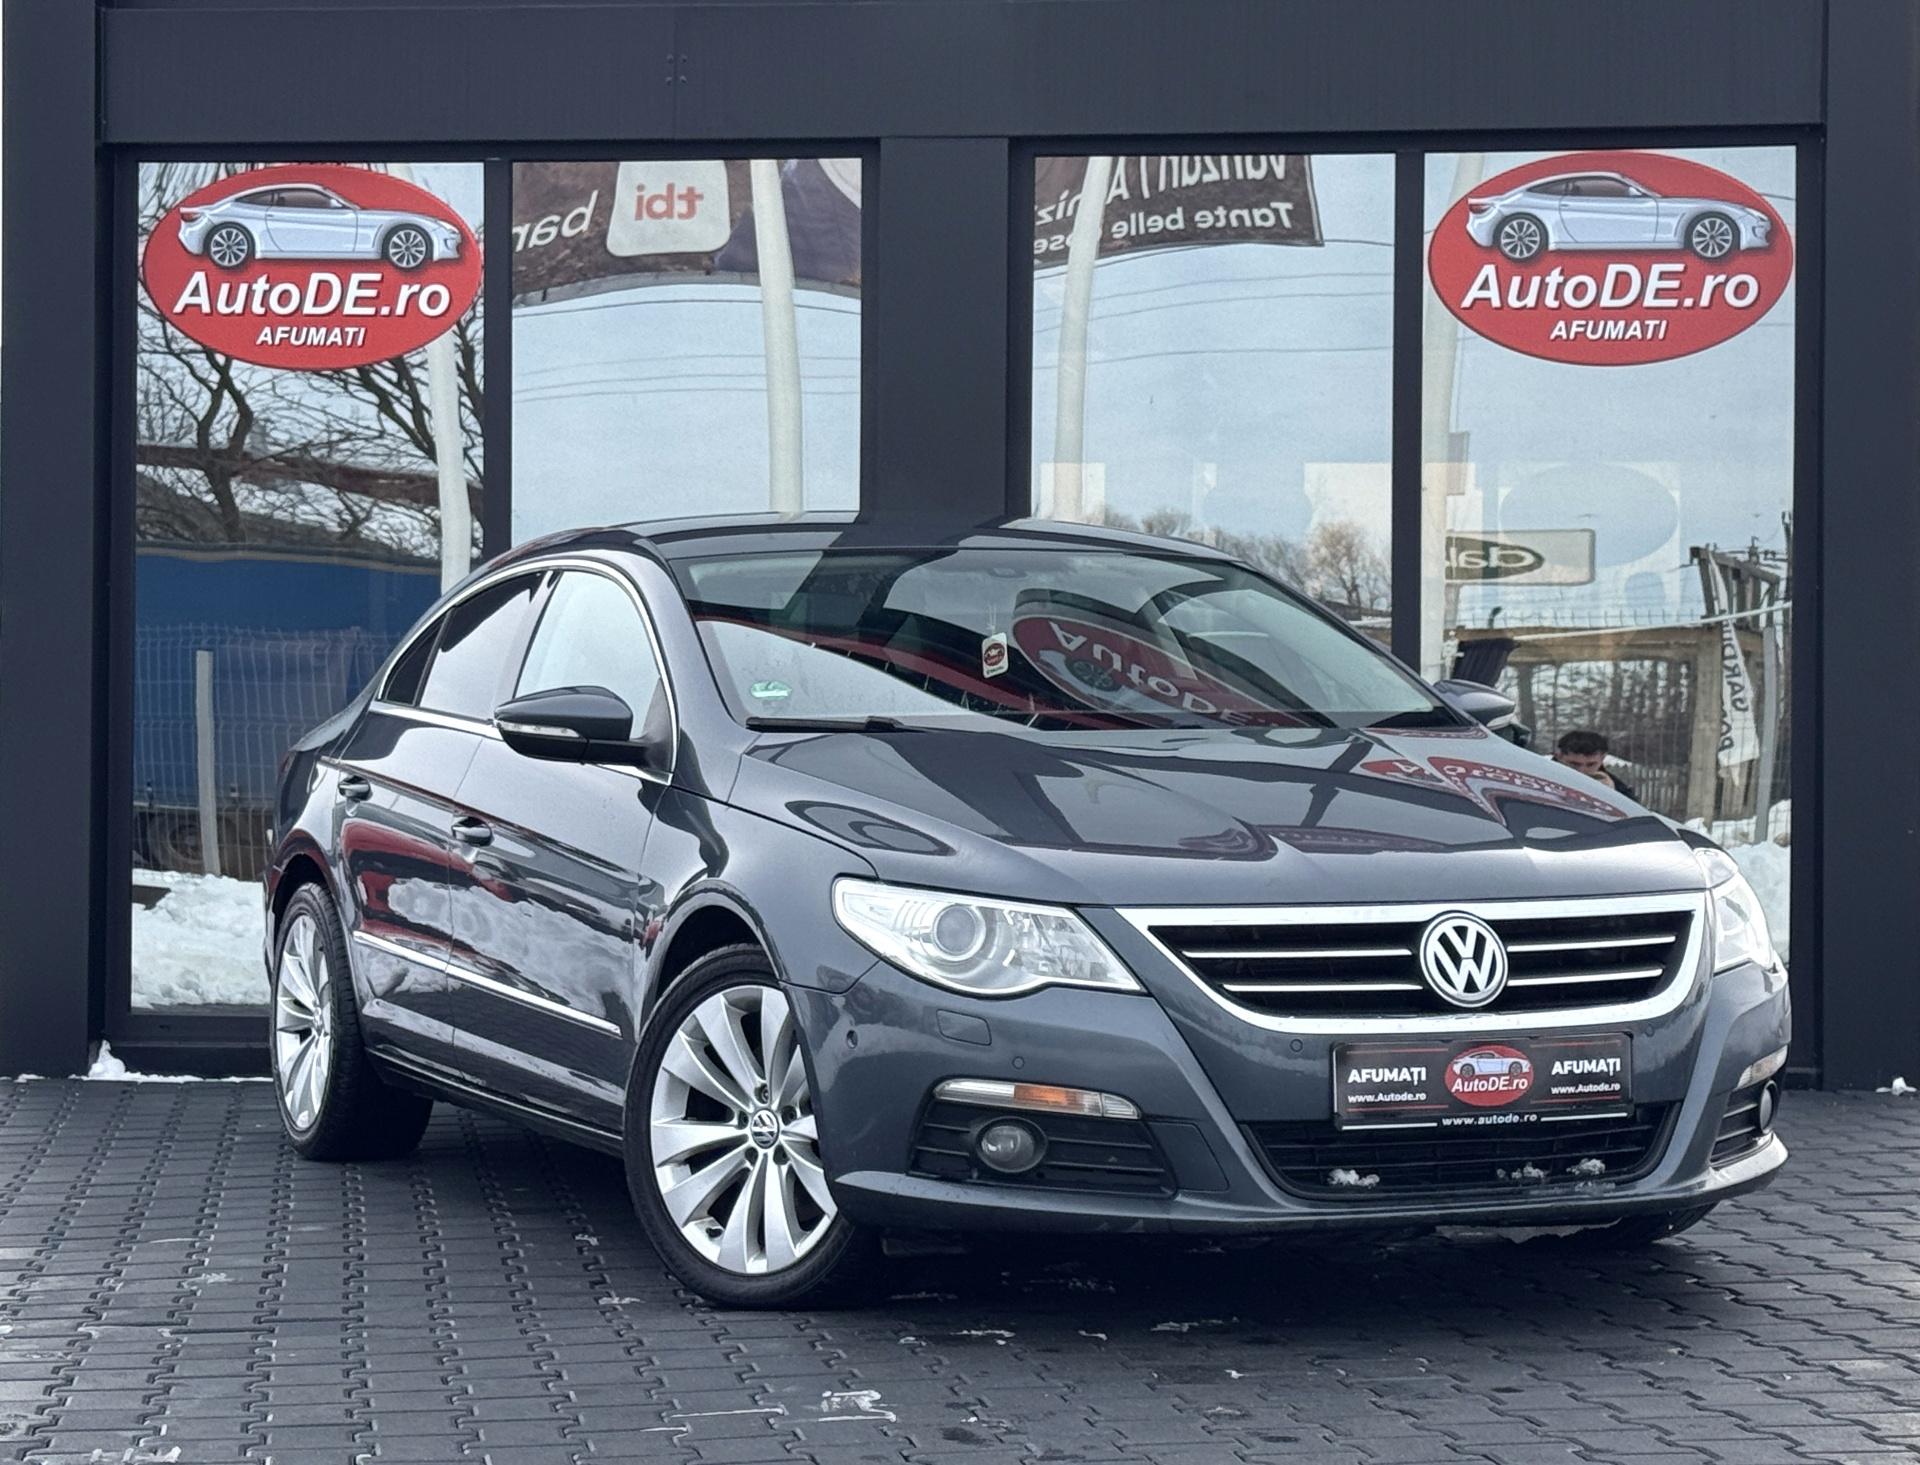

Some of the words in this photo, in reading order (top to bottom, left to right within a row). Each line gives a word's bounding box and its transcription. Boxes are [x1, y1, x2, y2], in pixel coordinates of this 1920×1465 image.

[172, 271, 451, 318] AutoDE.ro
[1460, 263, 1760, 309] AutoDE.ro
[256, 326, 368, 347] AFUMATI
[1550, 319, 1667, 341] AFUMATI
[1451, 1076, 1529, 1093] AutoDE.ro
[1441, 1113, 1538, 1126] www.autode.ro
